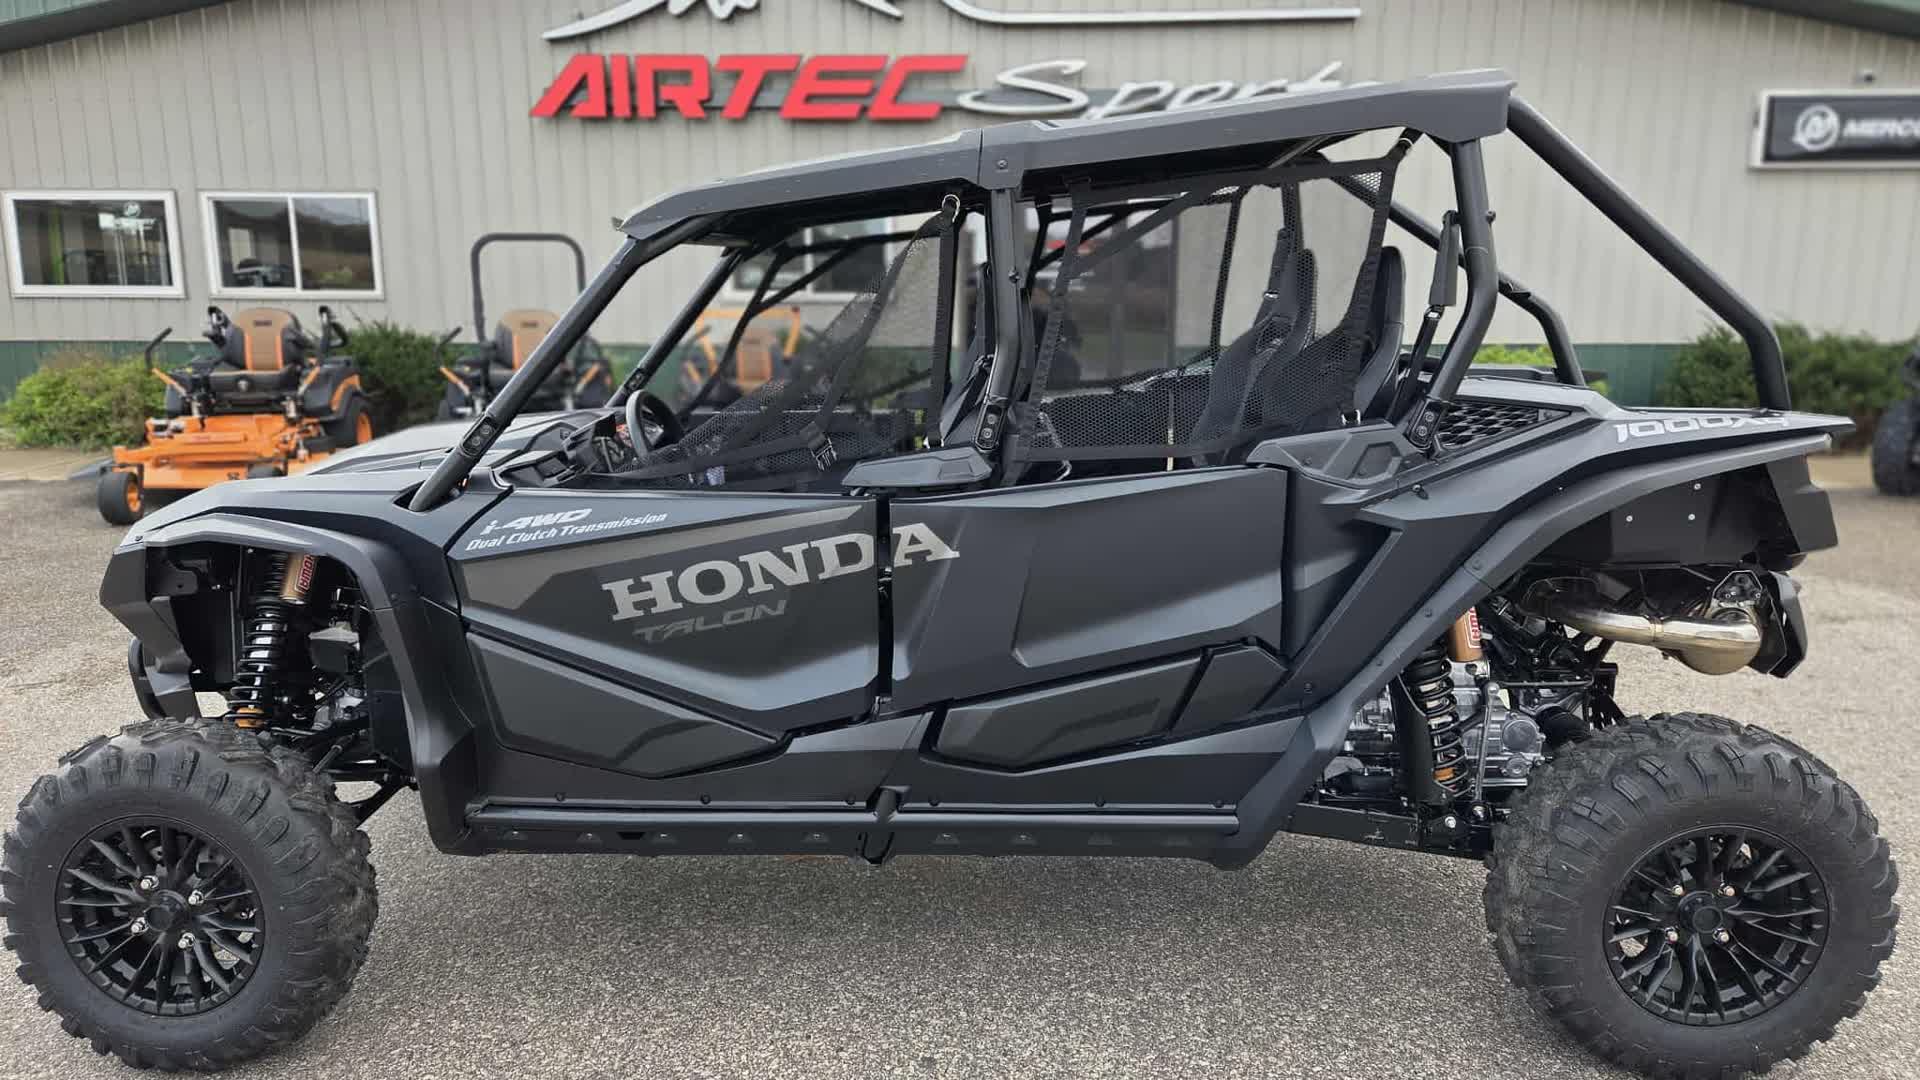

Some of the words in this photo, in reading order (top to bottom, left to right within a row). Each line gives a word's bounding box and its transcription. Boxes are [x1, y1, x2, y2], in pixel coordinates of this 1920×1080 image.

[529, 53, 968, 119] AIRTEC
[957, 59, 1384, 120] Sport
[465, 536, 505, 551] Dual
[506, 528, 558, 545] Clutch
[559, 512, 669, 537] Transmission
[602, 522, 960, 621] HONDA
[632, 599, 787, 641] TALON
